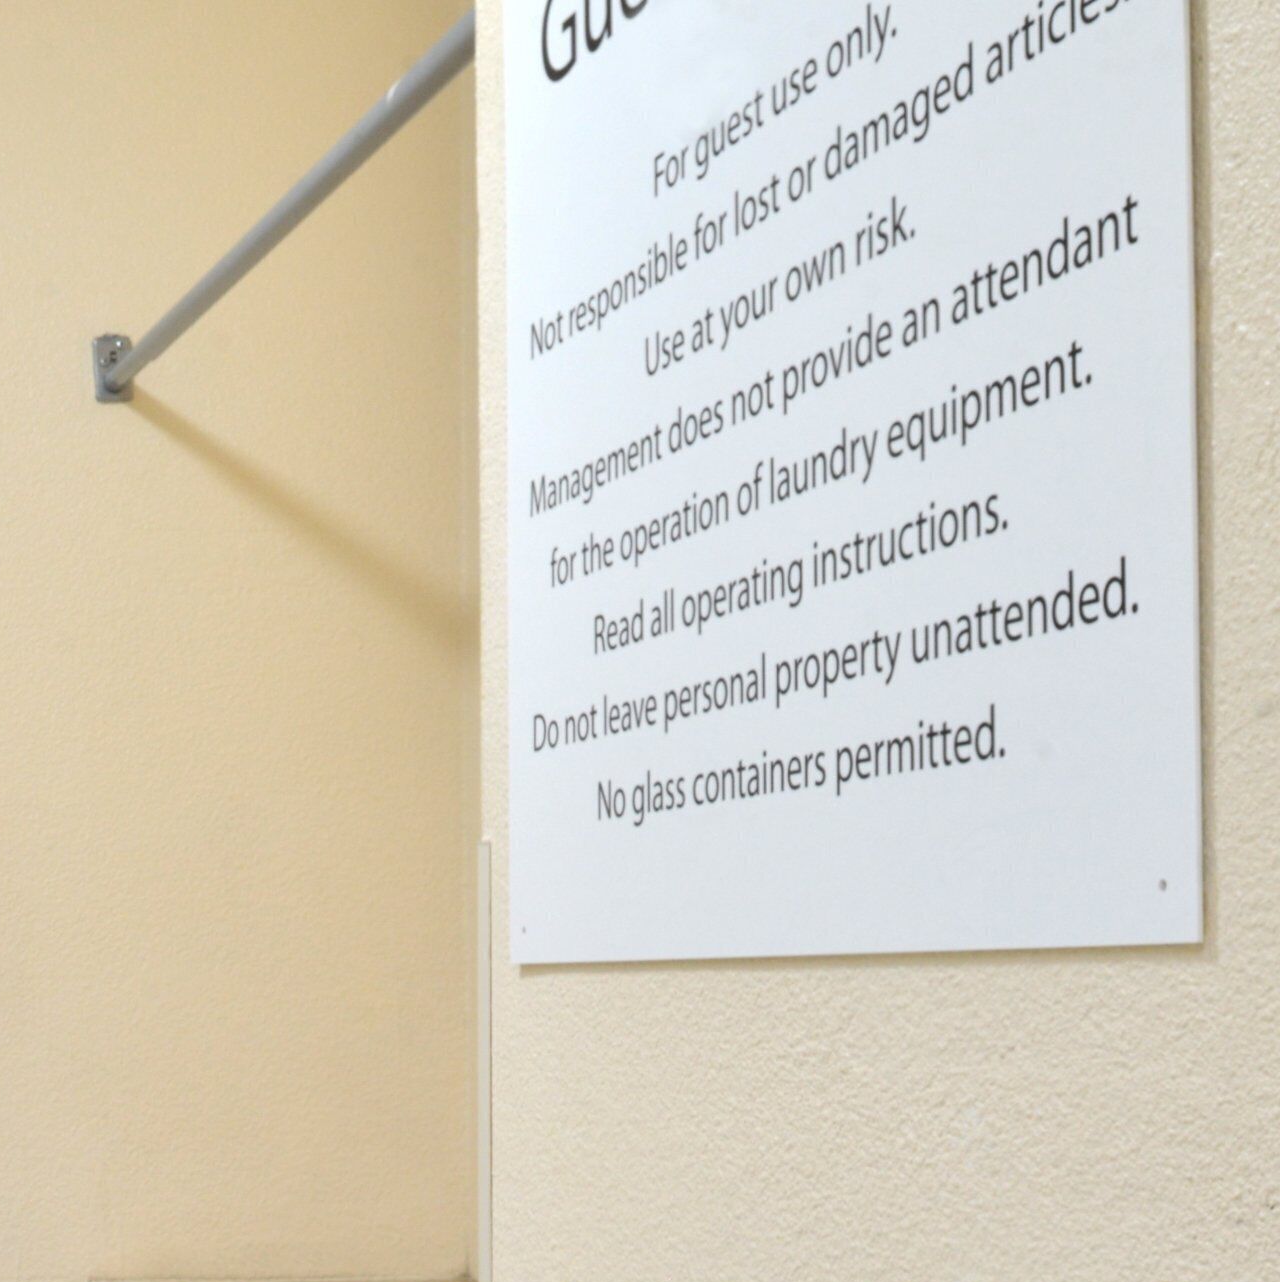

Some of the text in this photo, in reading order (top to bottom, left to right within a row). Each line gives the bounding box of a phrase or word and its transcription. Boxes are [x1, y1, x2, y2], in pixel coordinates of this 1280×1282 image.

[541, 0, 648, 82] Gu
[653, 2, 898, 198] For guest use only.
[530, 0, 1131, 360] Not responsible for lost or damaged article
[530, 193, 1139, 518] Management does not provide an attendant
[645, 195, 916, 377] Use at your own risk.
[550, 340, 1093, 588] for the operation of laundry equipment.
[532, 555, 1139, 753] Do not leave personal property unattended.
[594, 493, 1009, 655] Read all operating instructions.
[597, 703, 1006, 828] No glass containers permitted.
